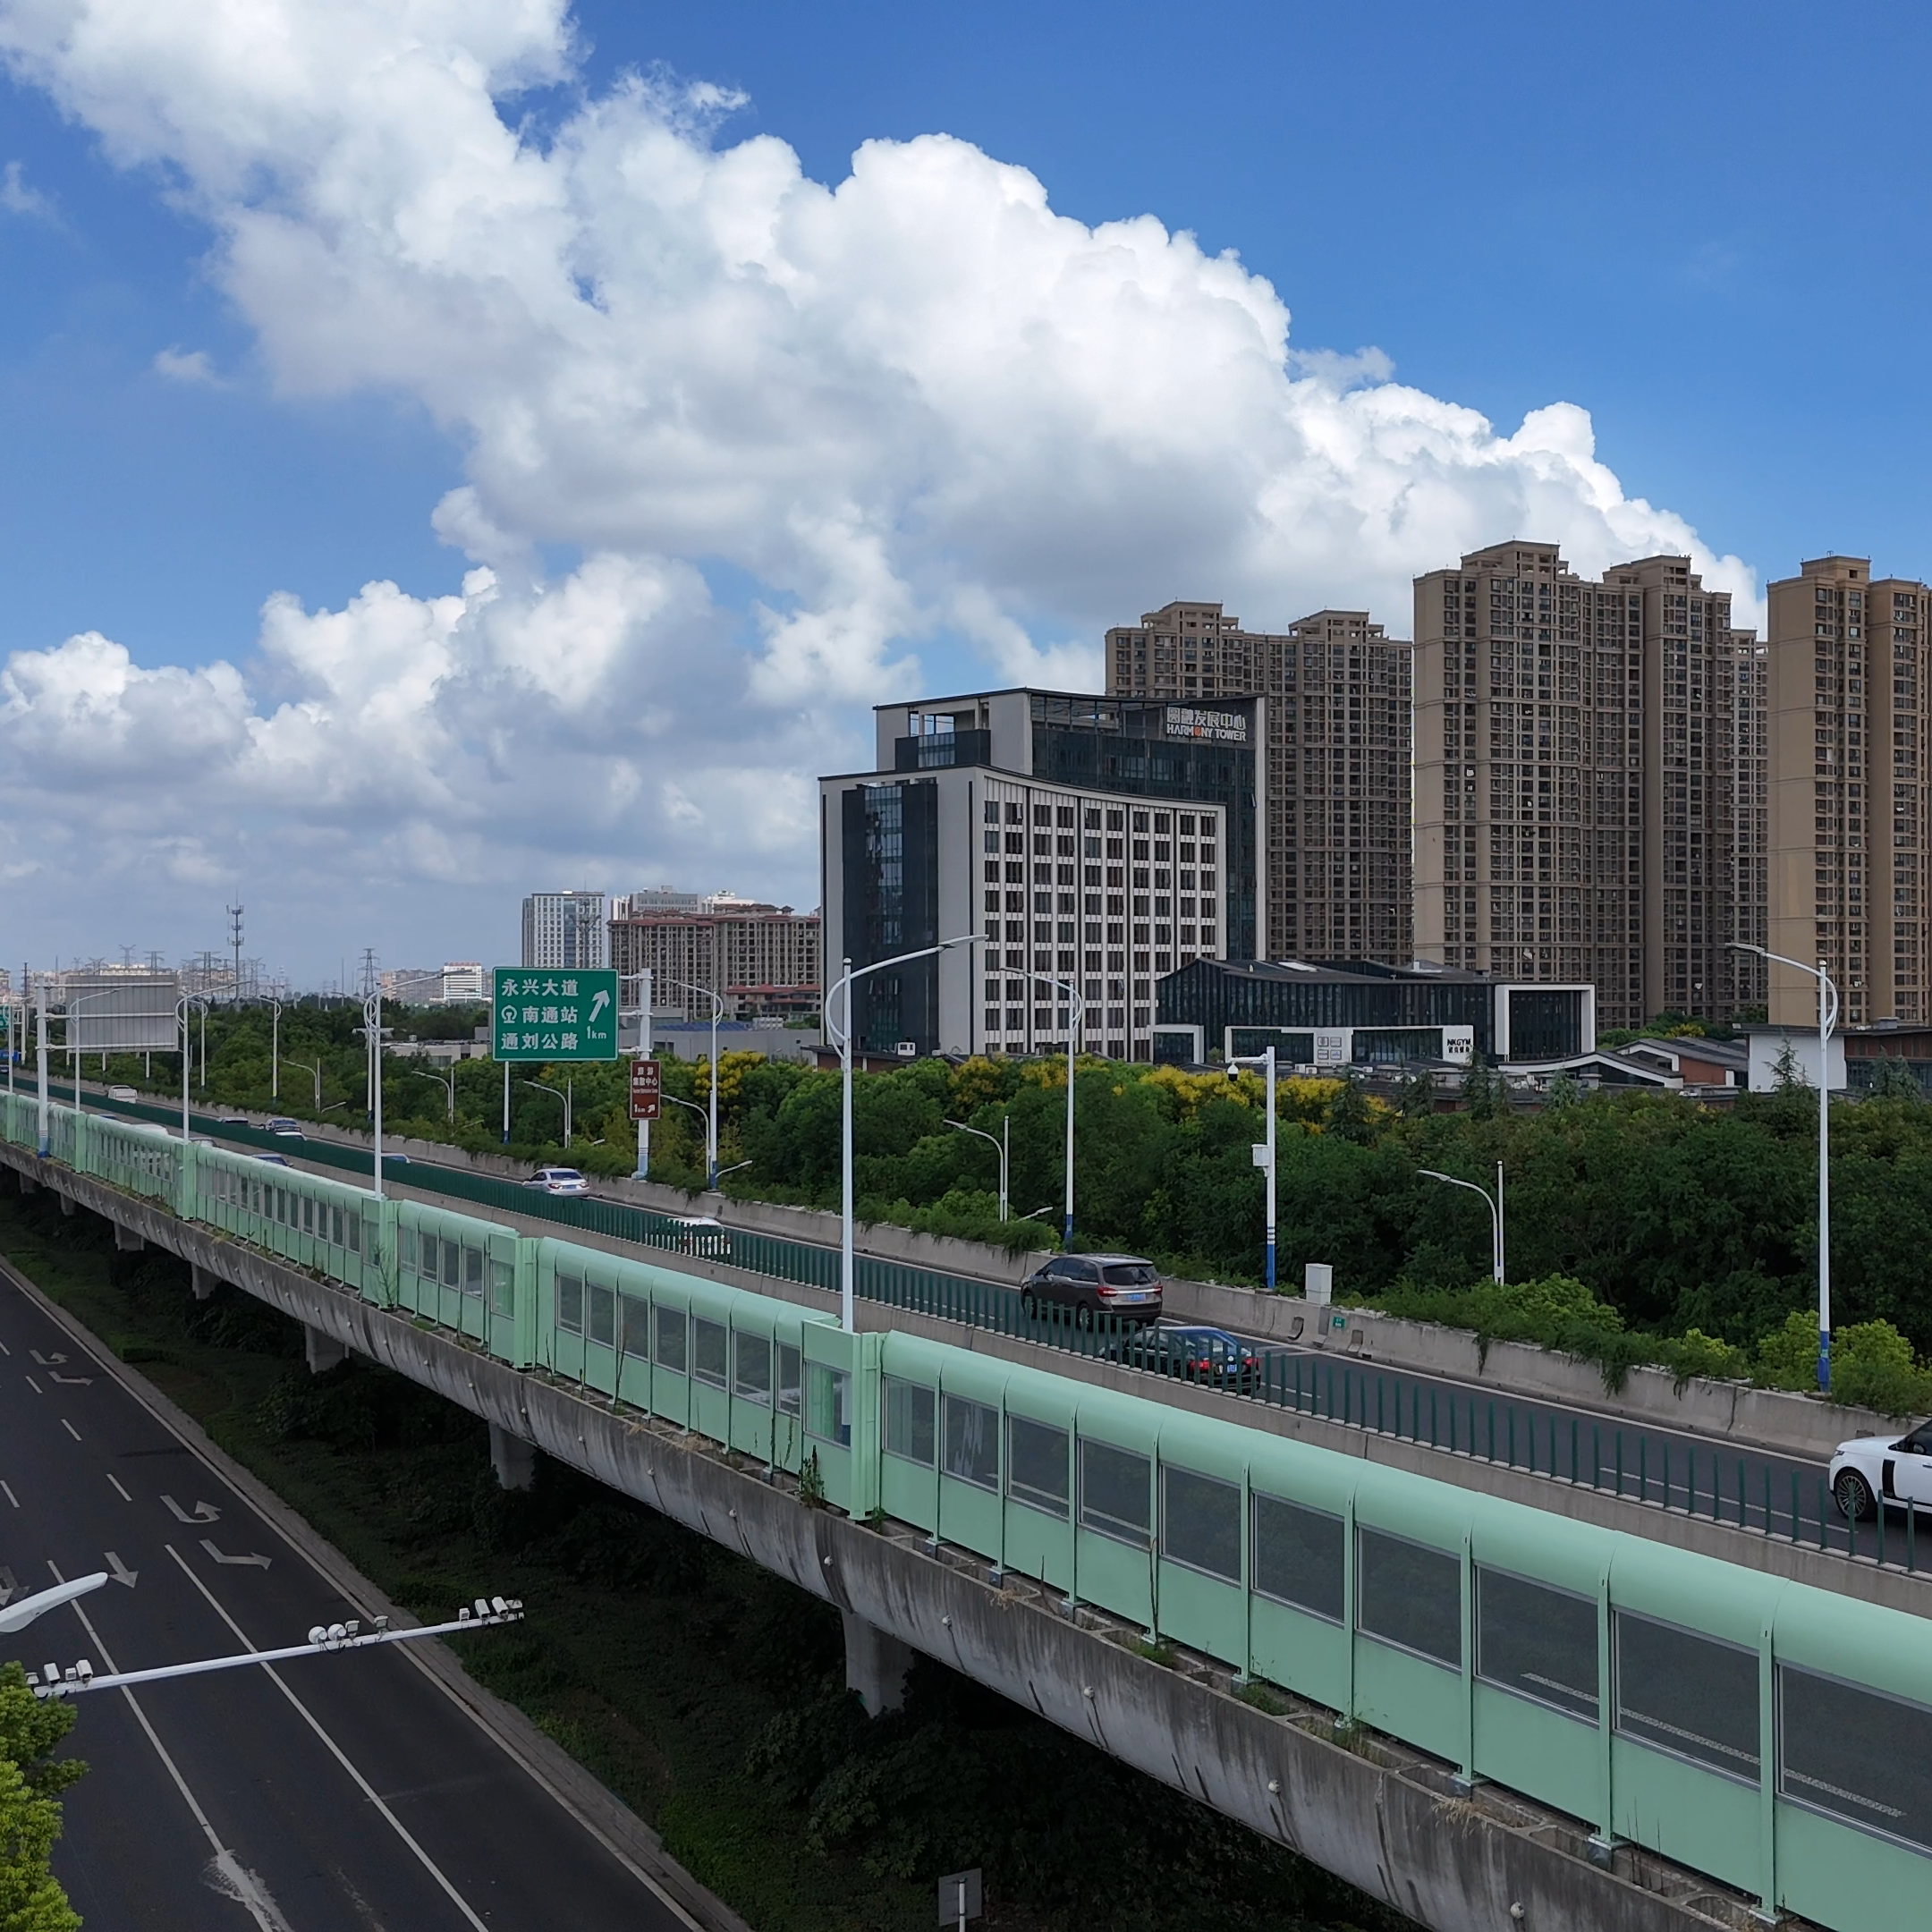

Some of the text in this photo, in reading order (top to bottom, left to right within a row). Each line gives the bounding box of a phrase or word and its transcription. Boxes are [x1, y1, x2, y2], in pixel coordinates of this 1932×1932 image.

[1166, 724, 1247, 741] HARMONY TOWER
[501, 979, 579, 996] 永兴大道
[521, 1006, 578, 1024] 南通站
[501, 1032, 579, 1050] 通刘公路
[586, 1026, 607, 1039] 1km
